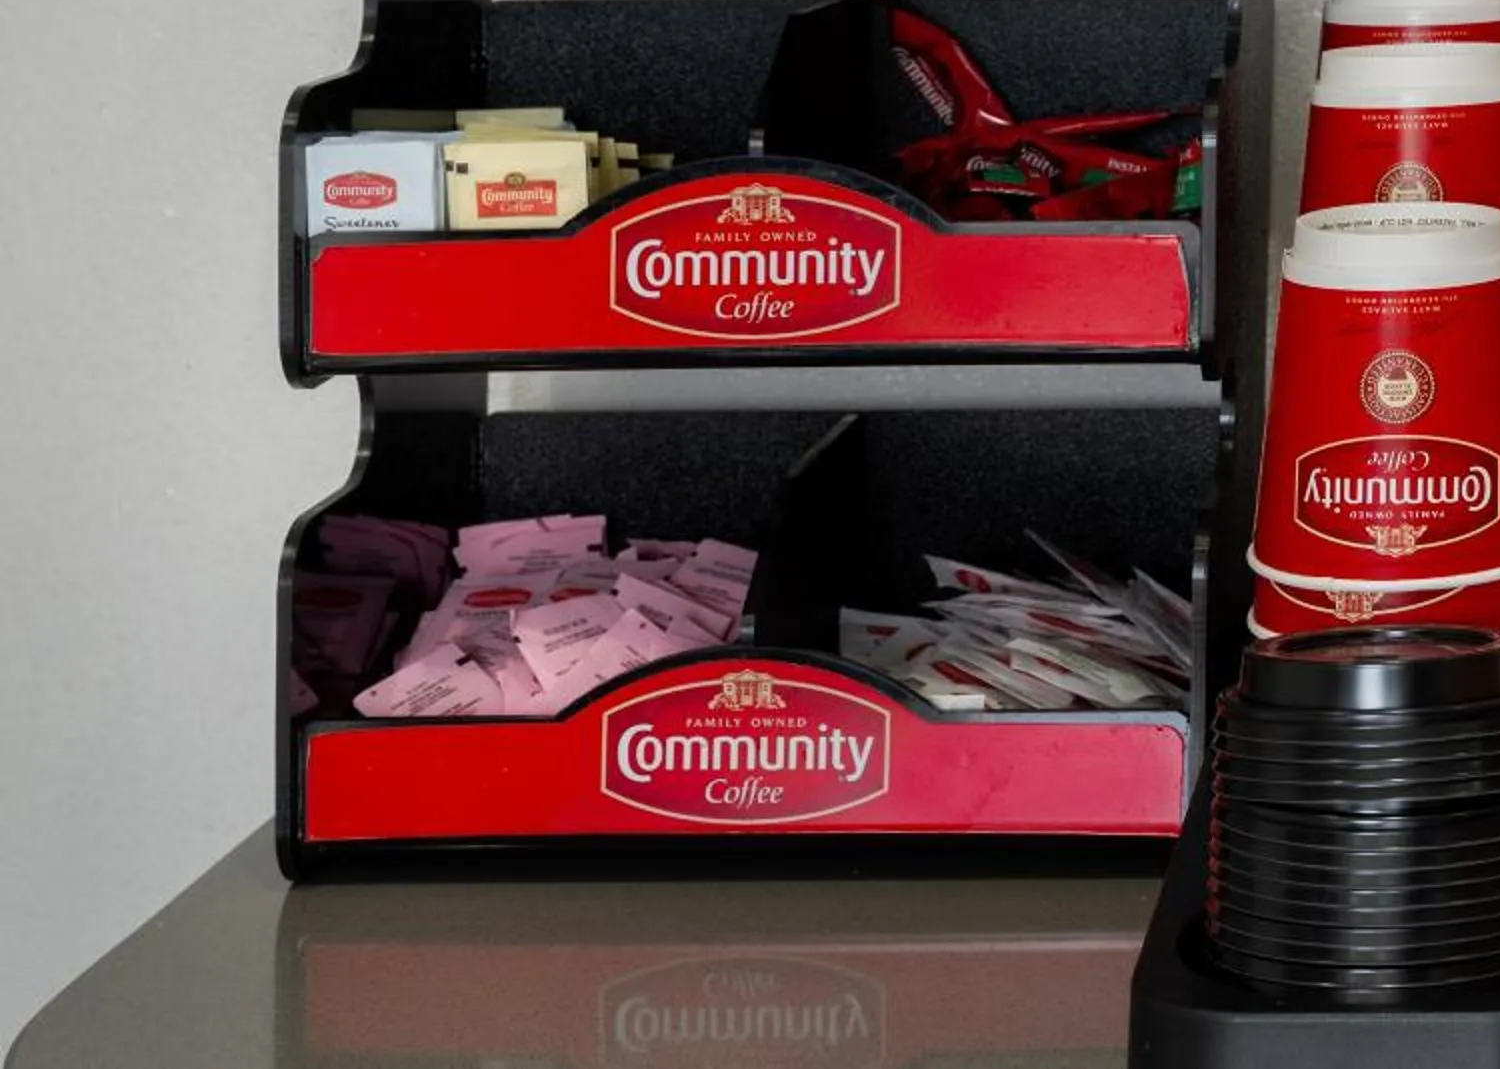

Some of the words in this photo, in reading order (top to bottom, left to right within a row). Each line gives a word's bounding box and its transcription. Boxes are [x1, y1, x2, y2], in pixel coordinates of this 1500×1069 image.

[694, 232, 752, 244] FAMILY
[760, 231, 818, 243] OWNED
[626, 237, 886, 298] Community
[714, 291, 795, 323] Coffee
[1367, 449, 1430, 472] Coffee
[1303, 465, 1492, 513] Community
[1349, 511, 1393, 520] OWNED
[685, 717, 742, 729] FAMILY
[750, 716, 807, 728] OWNED
[617, 722, 875, 783] Community
[703, 777, 785, 809] Coffee
